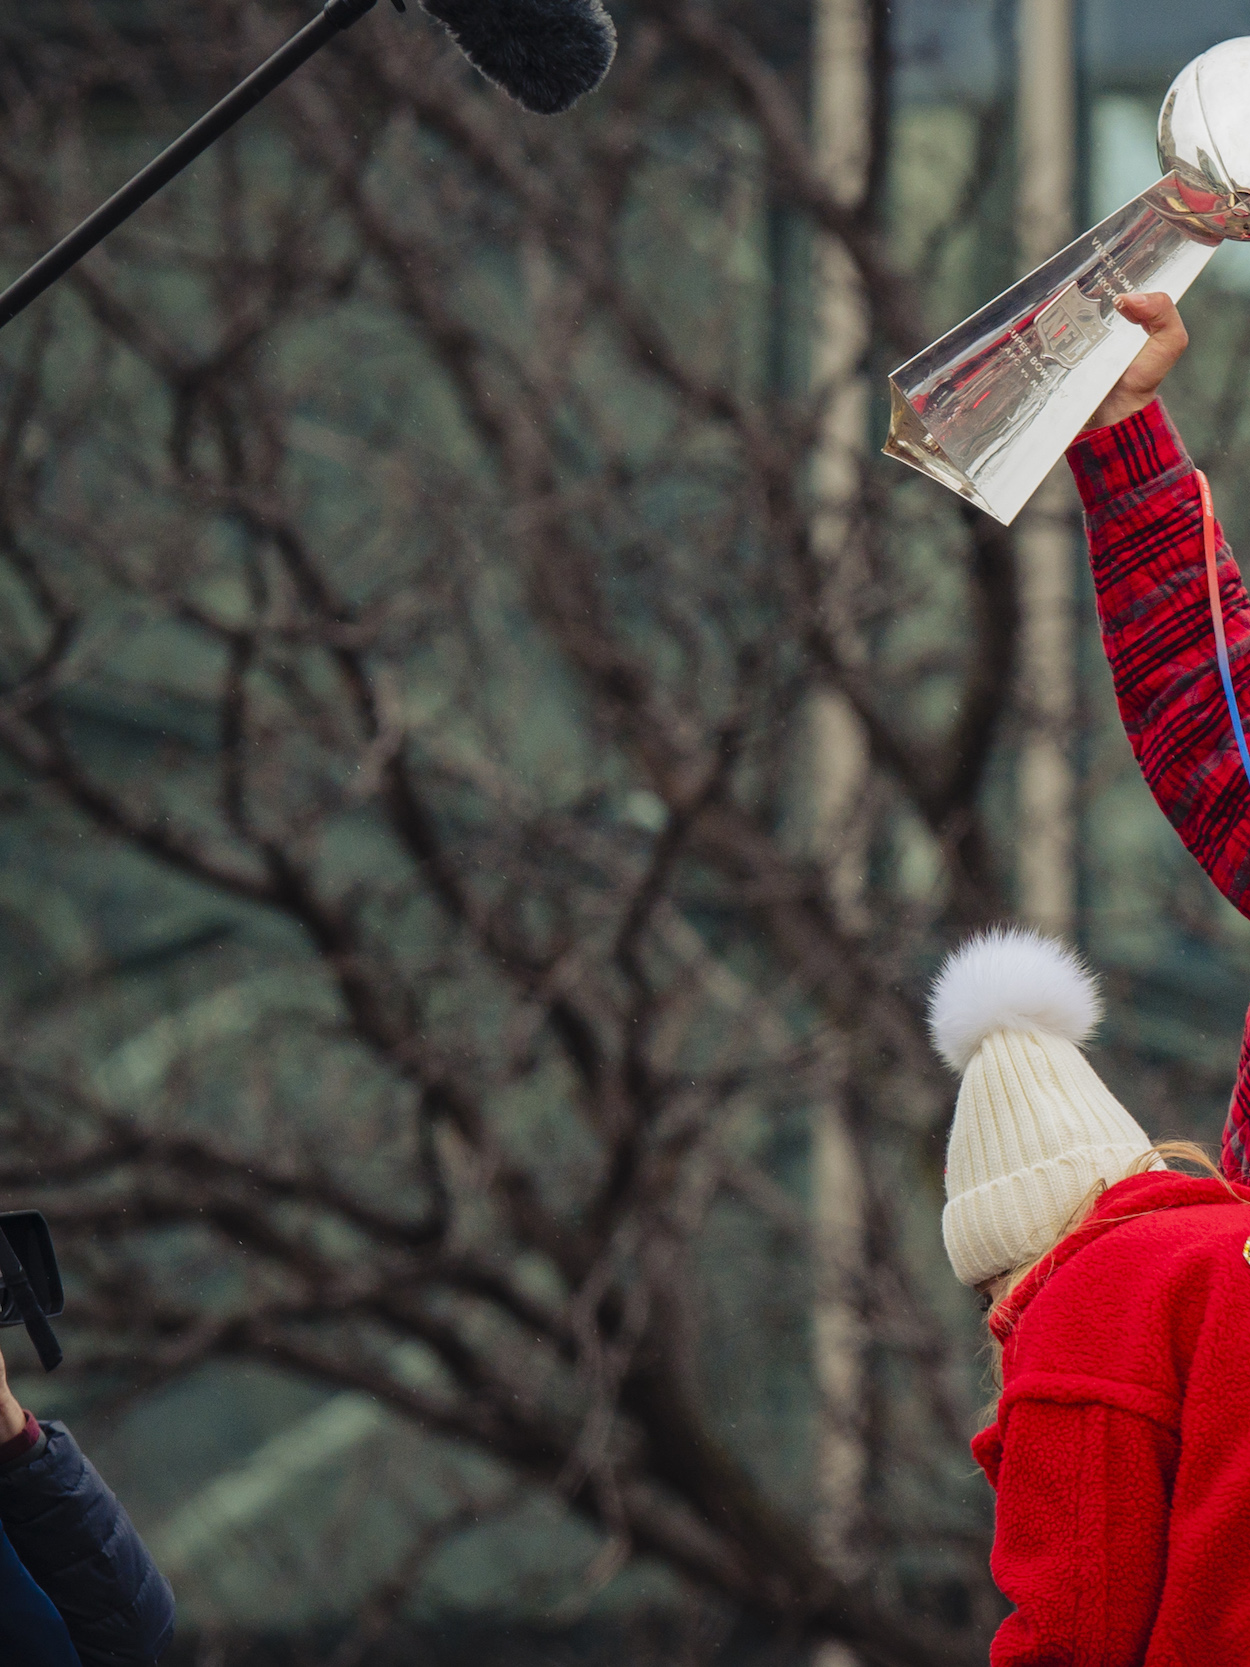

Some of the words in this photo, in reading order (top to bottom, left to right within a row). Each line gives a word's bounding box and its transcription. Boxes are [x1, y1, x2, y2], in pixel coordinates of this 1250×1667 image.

[1091, 236, 1116, 269] VINCE
[1041, 305, 1092, 362] NFL
[1004, 346, 1022, 367] AFC
